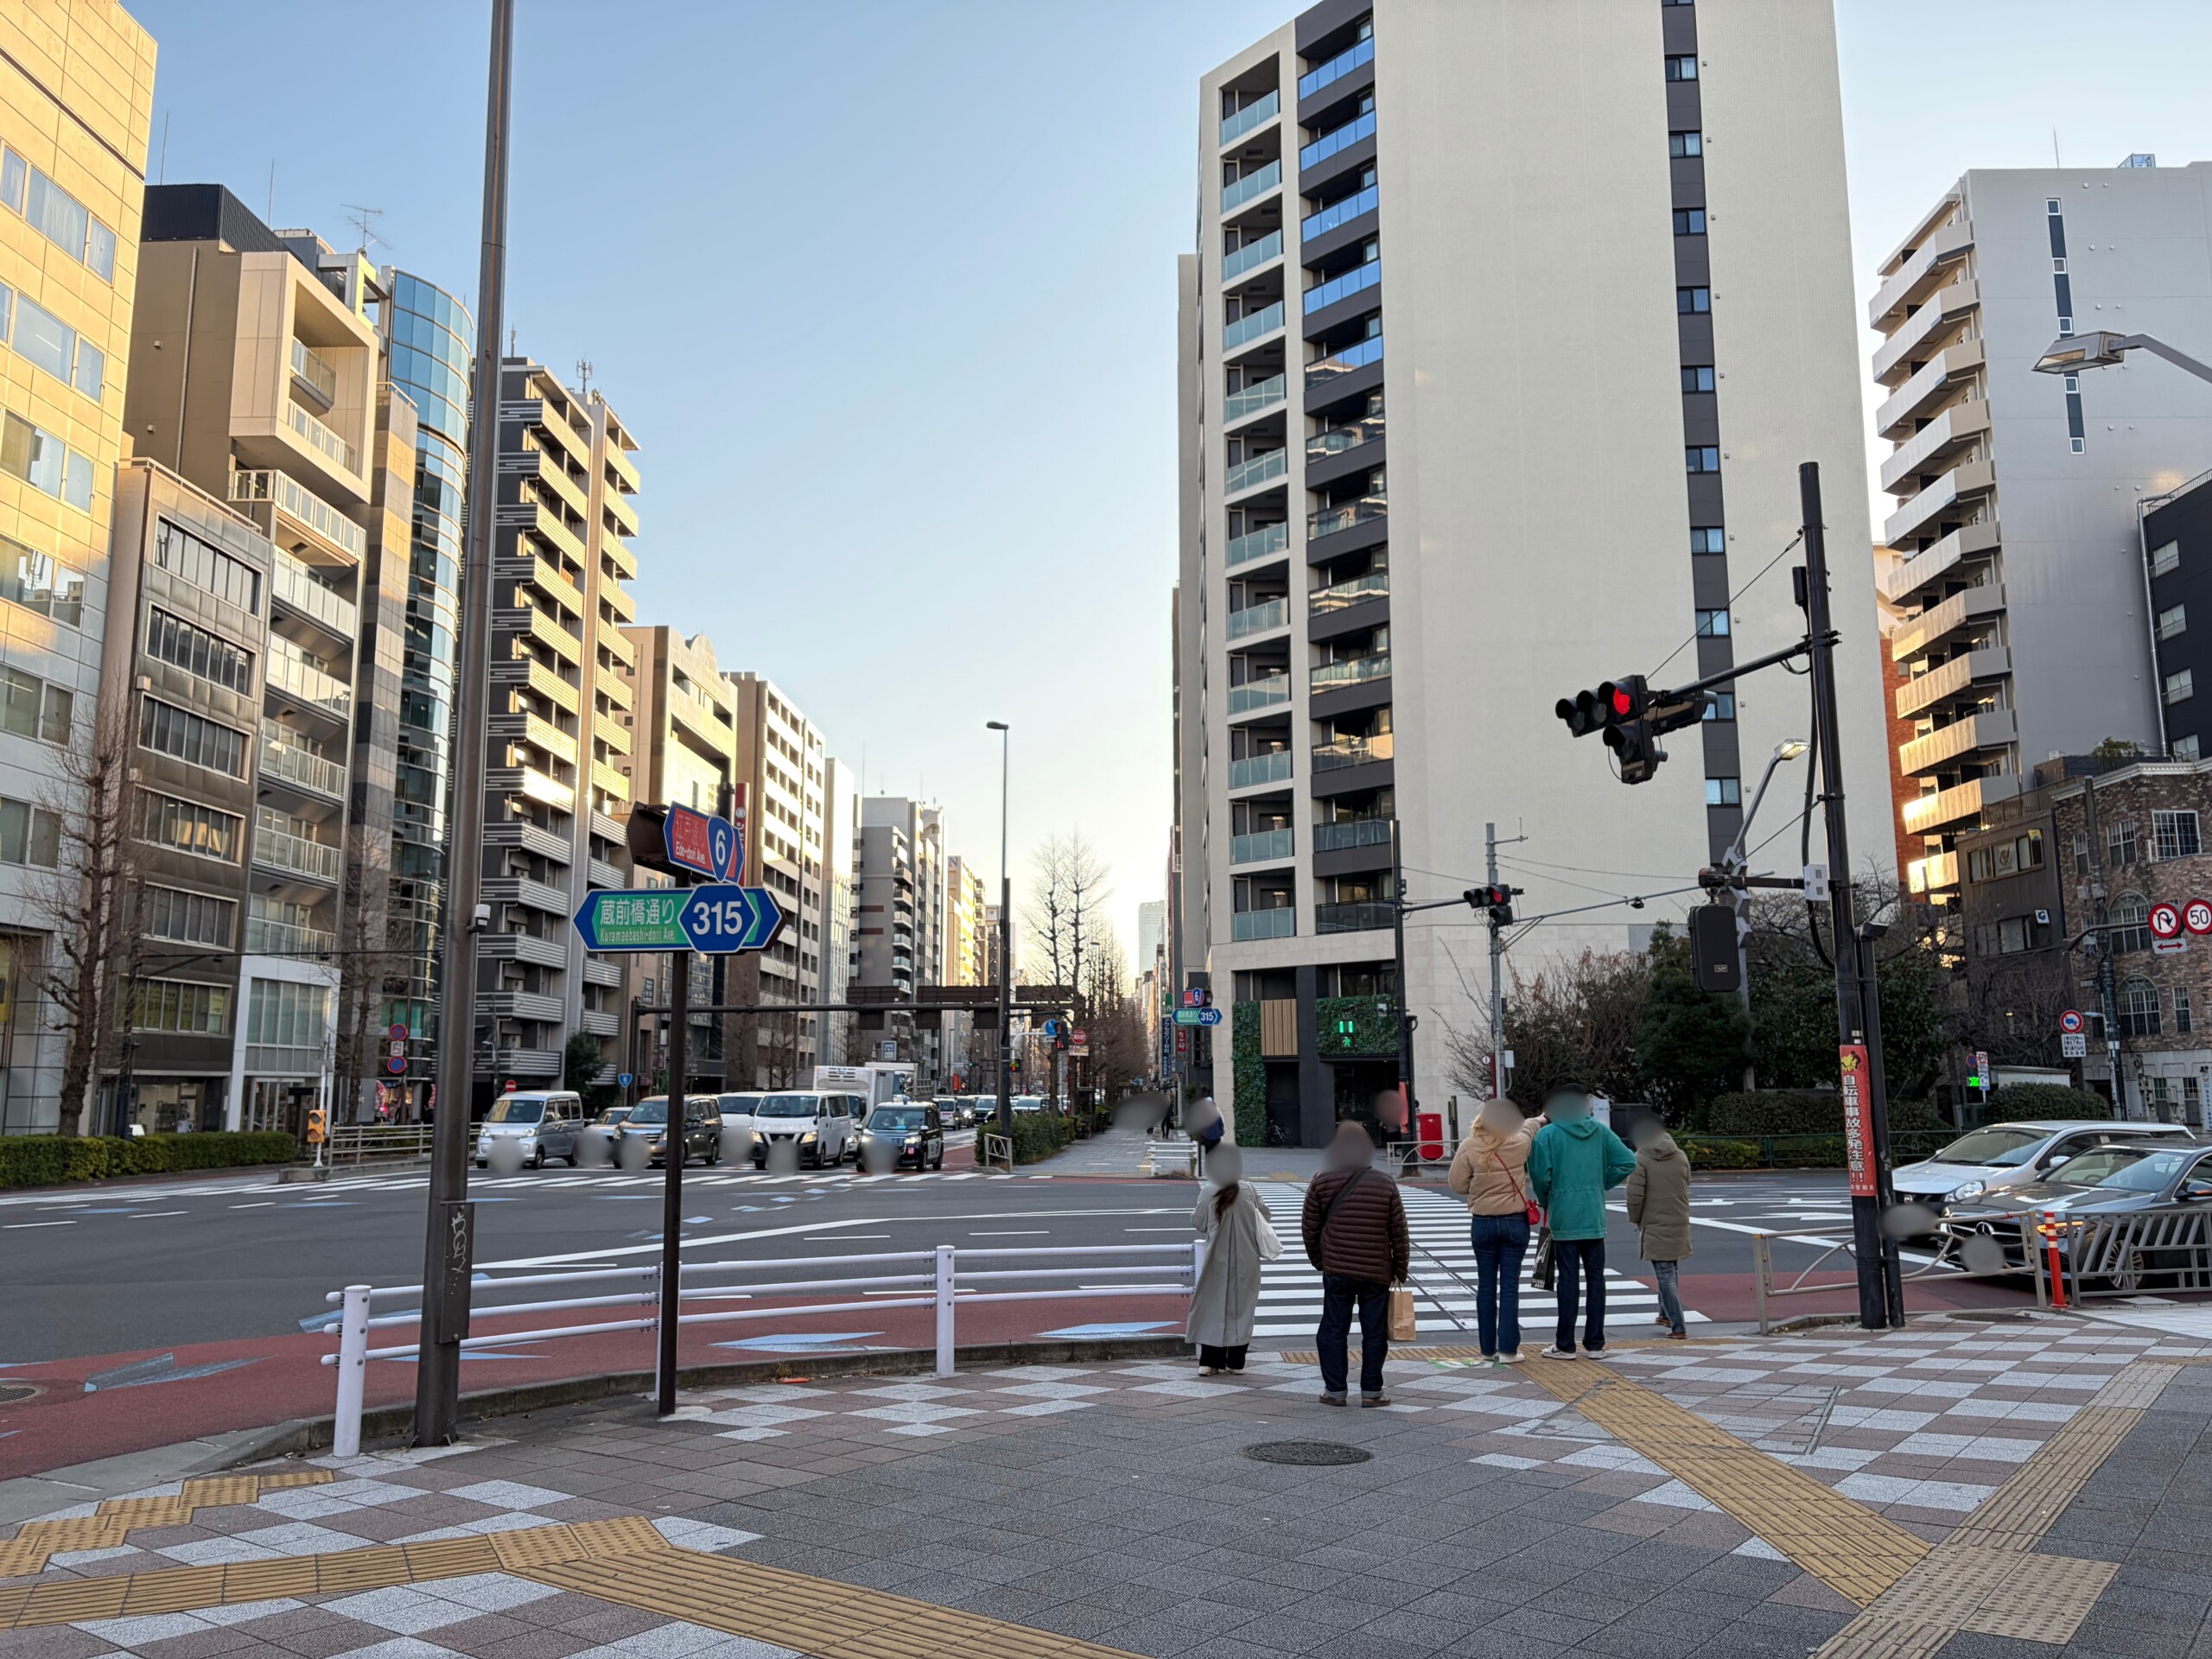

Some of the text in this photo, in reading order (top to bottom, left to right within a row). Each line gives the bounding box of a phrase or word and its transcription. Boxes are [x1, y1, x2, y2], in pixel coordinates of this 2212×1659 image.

[676, 841, 696, 861] Edo-dori
[715, 829, 726, 866] 6
[601, 899, 674, 925] 蔵前橋通り
[692, 901, 743, 935] 315
[2190, 909, 2209, 925] 50
[601, 926, 662, 942] Kuramaebashi-dori
[1194, 991, 1199, 1001] 6
[1200, 1012, 1214, 1021] 315
